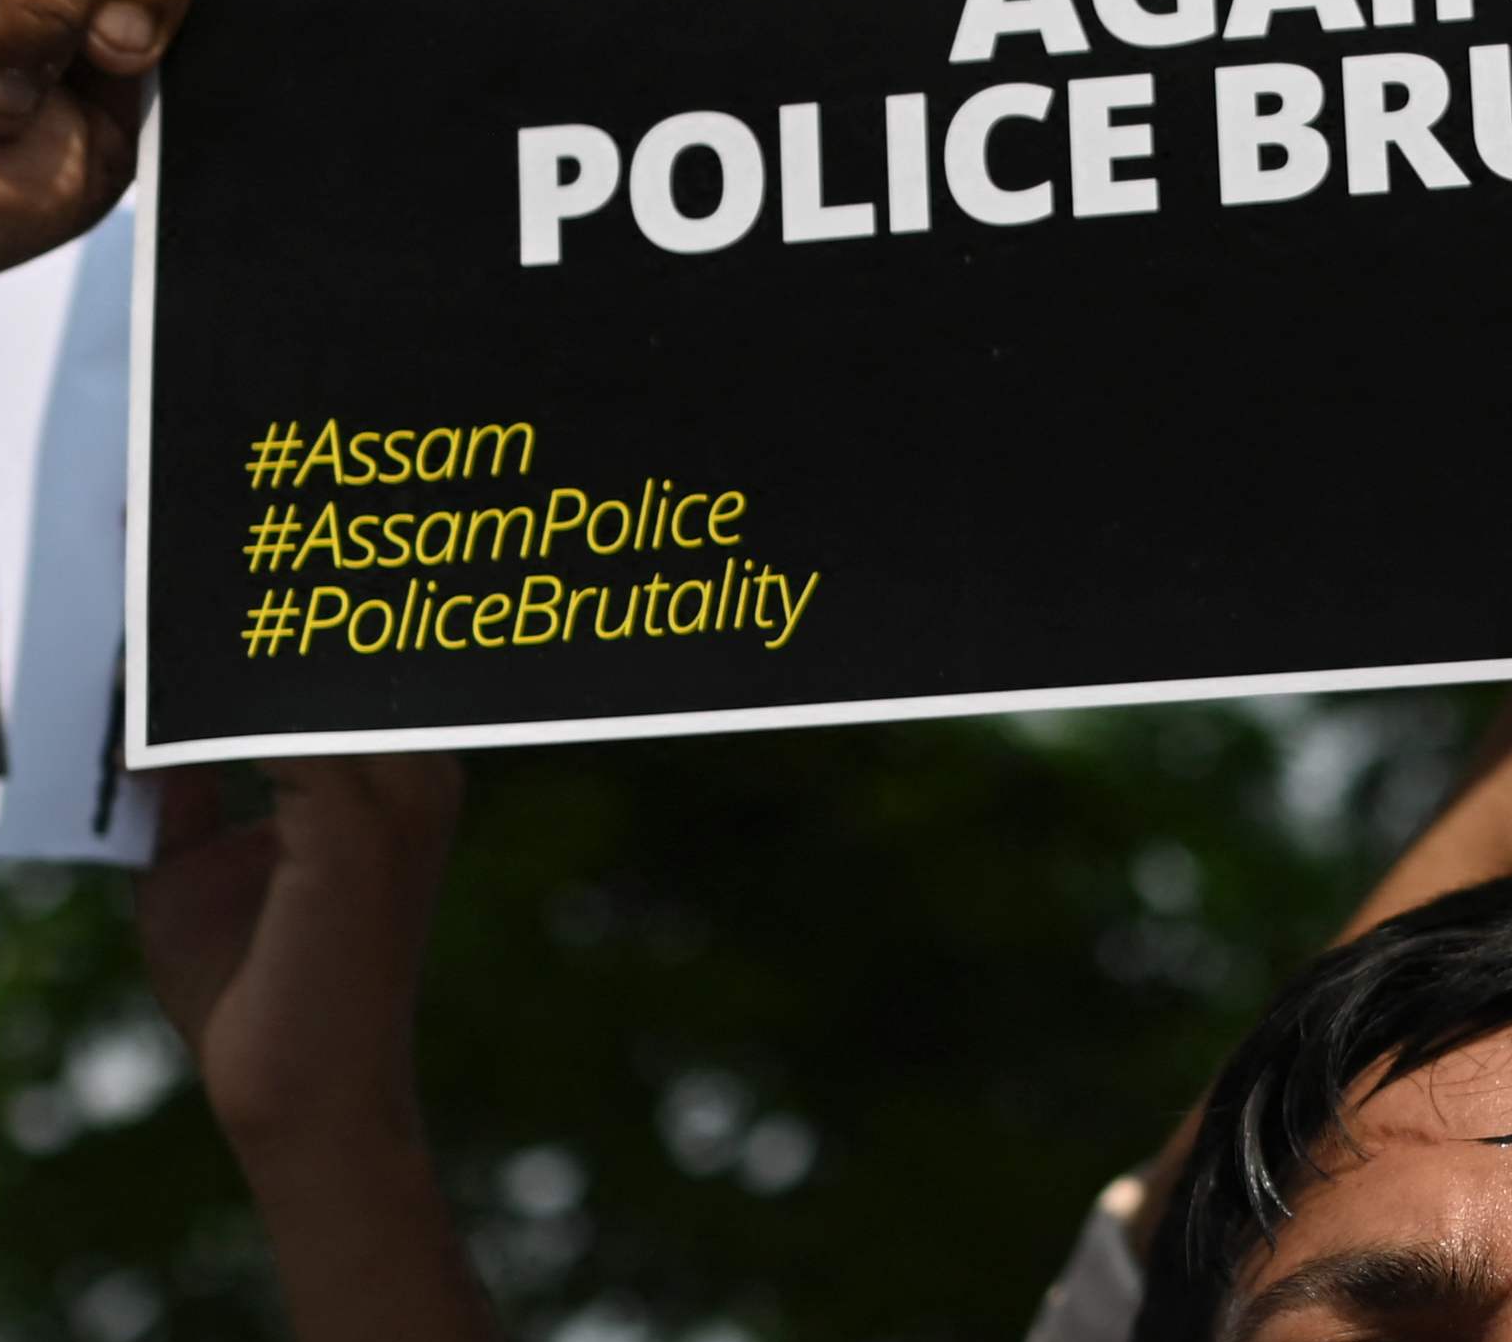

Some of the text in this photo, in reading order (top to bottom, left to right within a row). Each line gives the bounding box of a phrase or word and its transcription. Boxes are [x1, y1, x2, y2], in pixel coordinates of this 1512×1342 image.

[517, 72, 1159, 268] POLICE
[244, 417, 535, 489] #Assam
[242, 477, 746, 573] #AssamPolice
[240, 557, 820, 657] #PoliceBrutality
